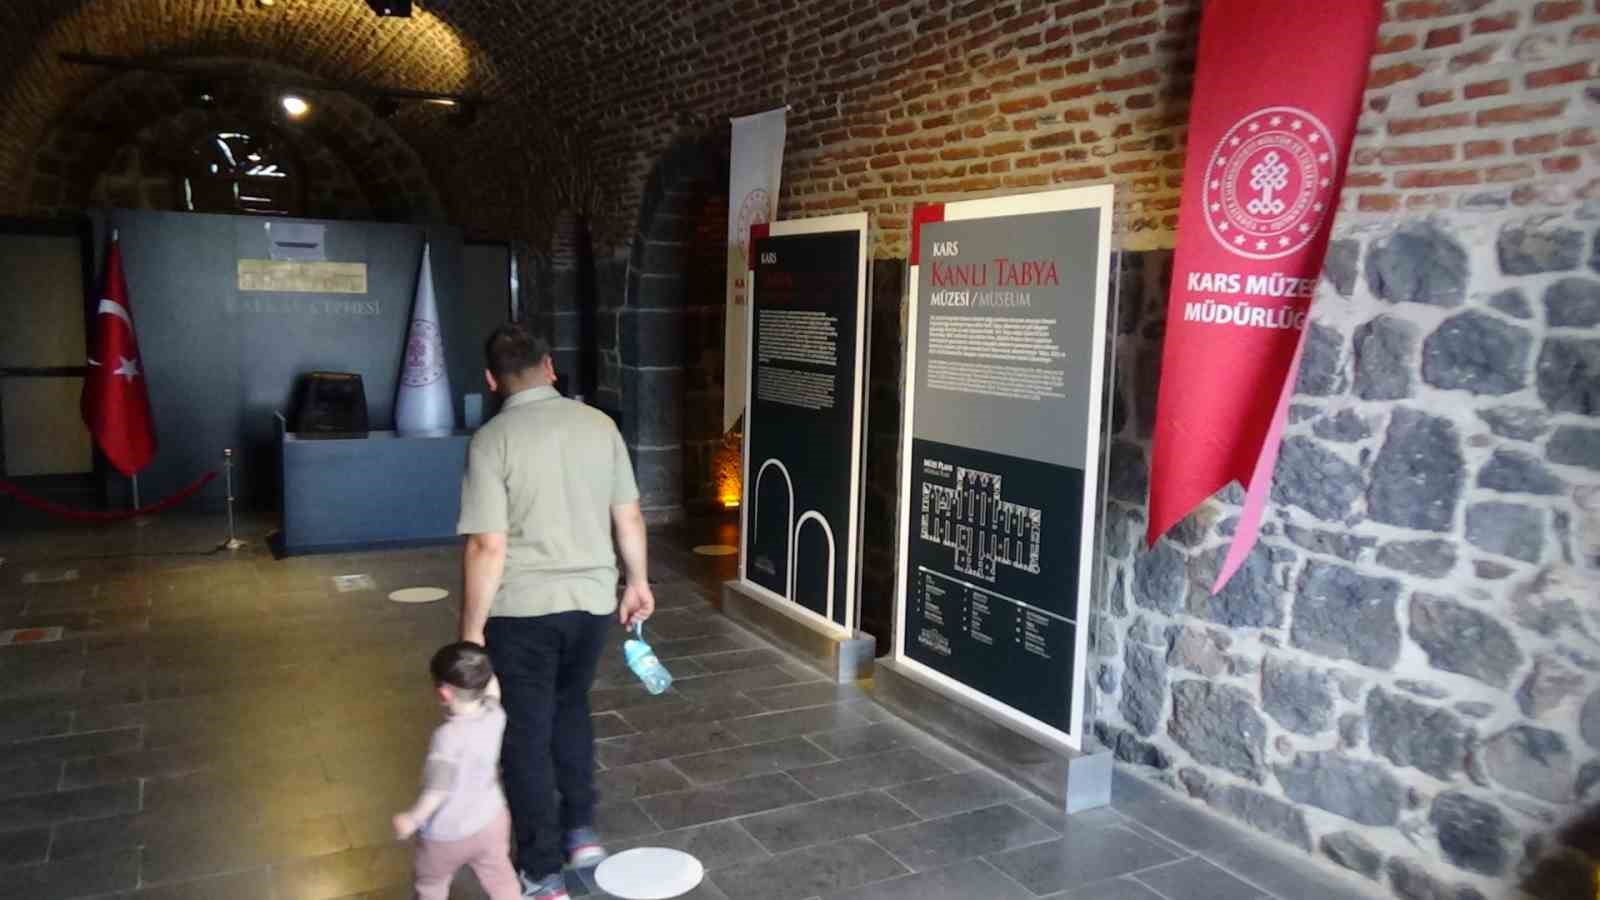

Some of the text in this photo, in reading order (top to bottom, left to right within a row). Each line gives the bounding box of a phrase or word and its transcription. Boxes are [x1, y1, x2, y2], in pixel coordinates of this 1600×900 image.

[933, 240, 959, 257] KARS
[931, 257, 1059, 287] KANLI TABYA
[1187, 272, 1241, 294] KARS
